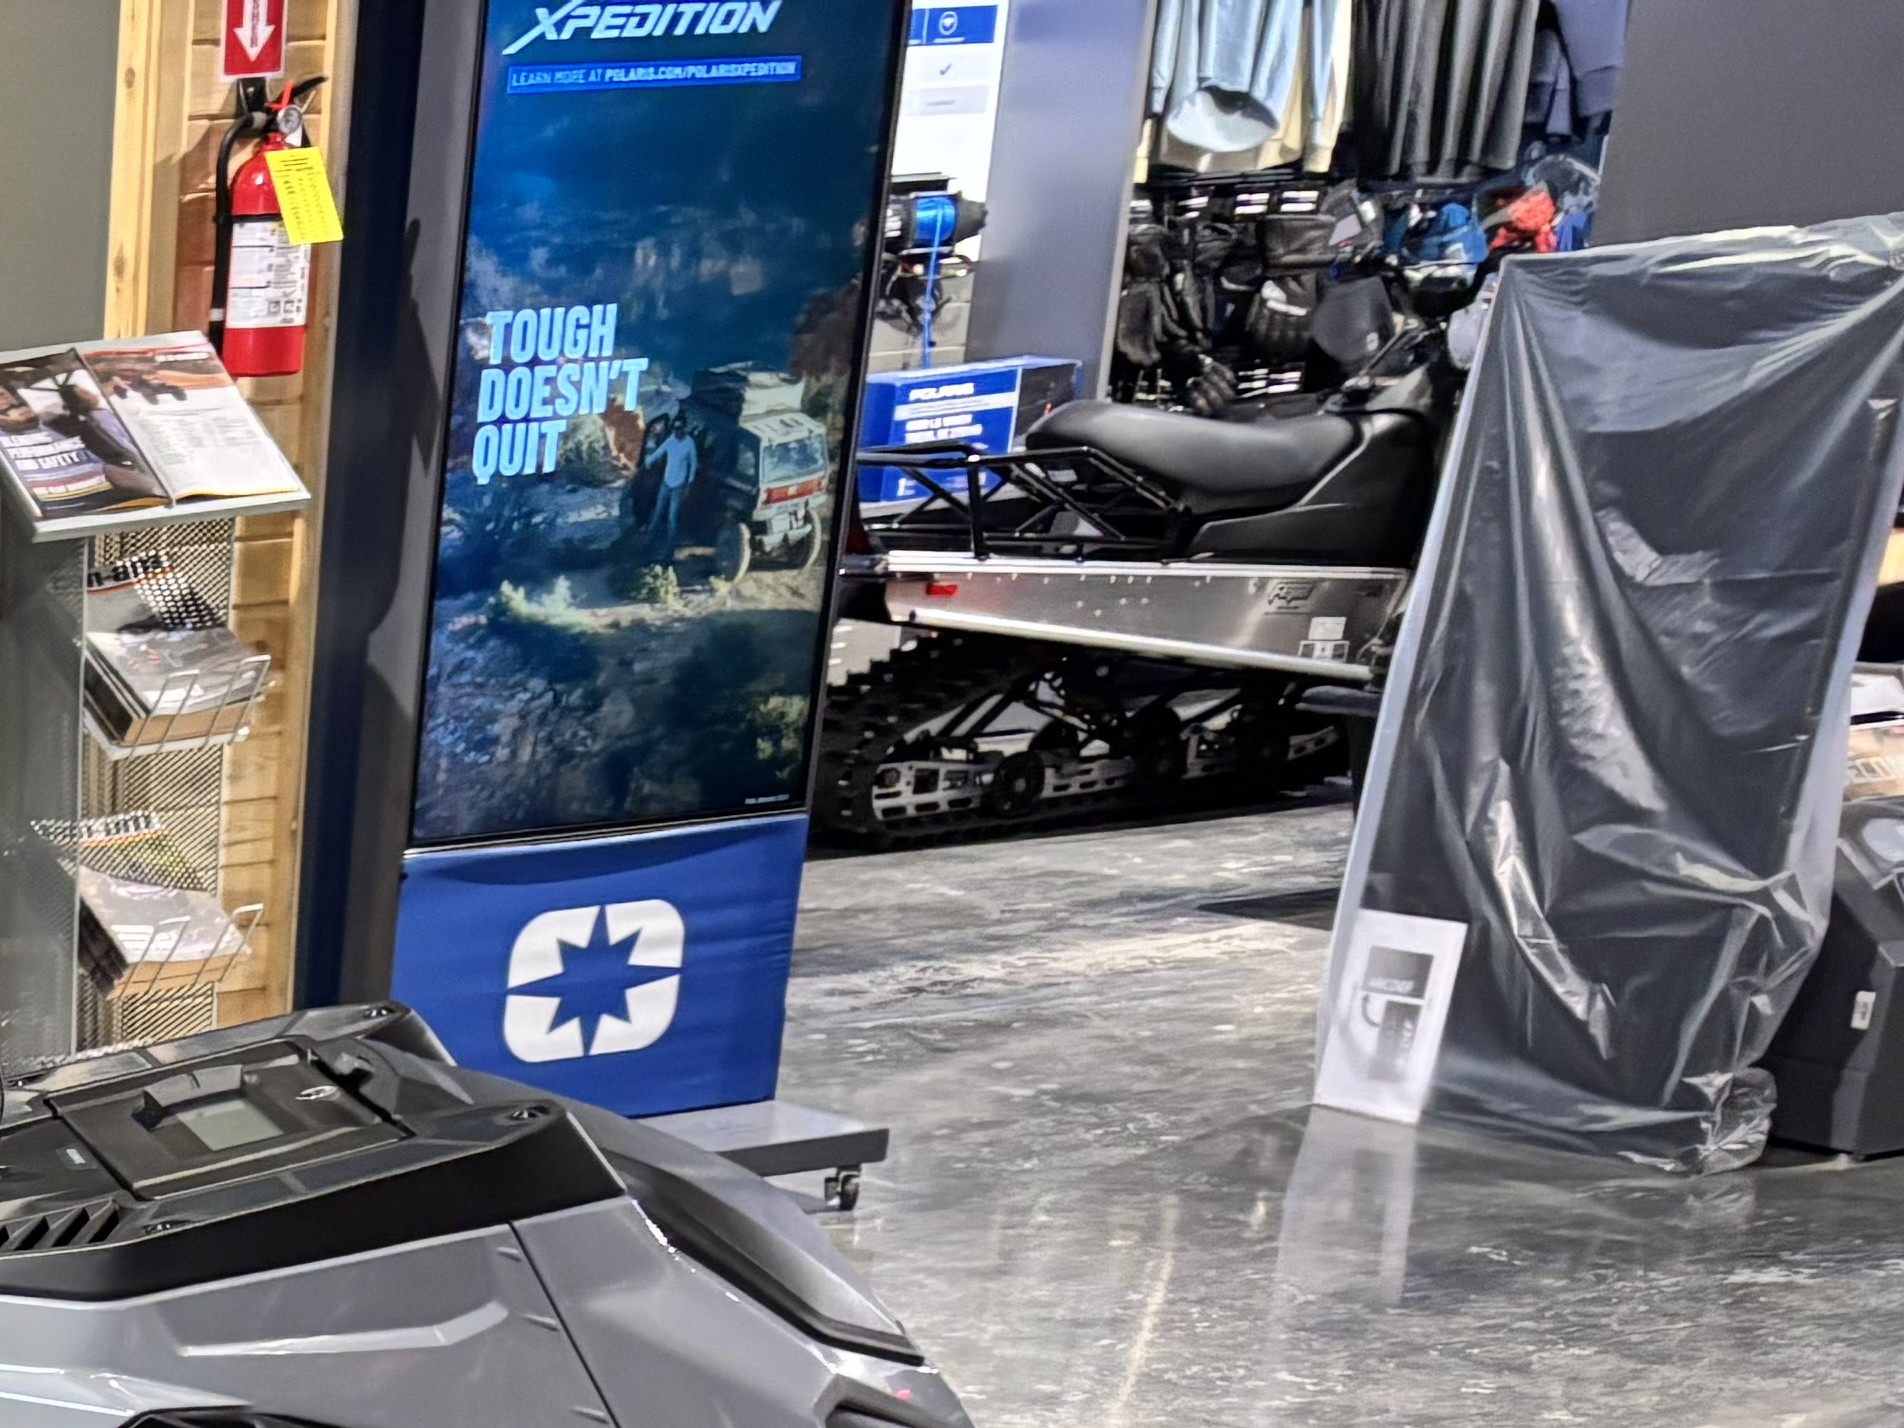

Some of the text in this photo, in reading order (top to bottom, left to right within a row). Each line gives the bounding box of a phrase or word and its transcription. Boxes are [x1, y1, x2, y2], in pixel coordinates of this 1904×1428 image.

[501, 0, 783, 56] XPEDITION
[511, 71, 552, 87] LEARN
[553, 69, 586, 84] MORE
[485, 303, 618, 365] TOUGH
[477, 358, 649, 424] DOESN'T
[472, 420, 567, 485] QUIT
